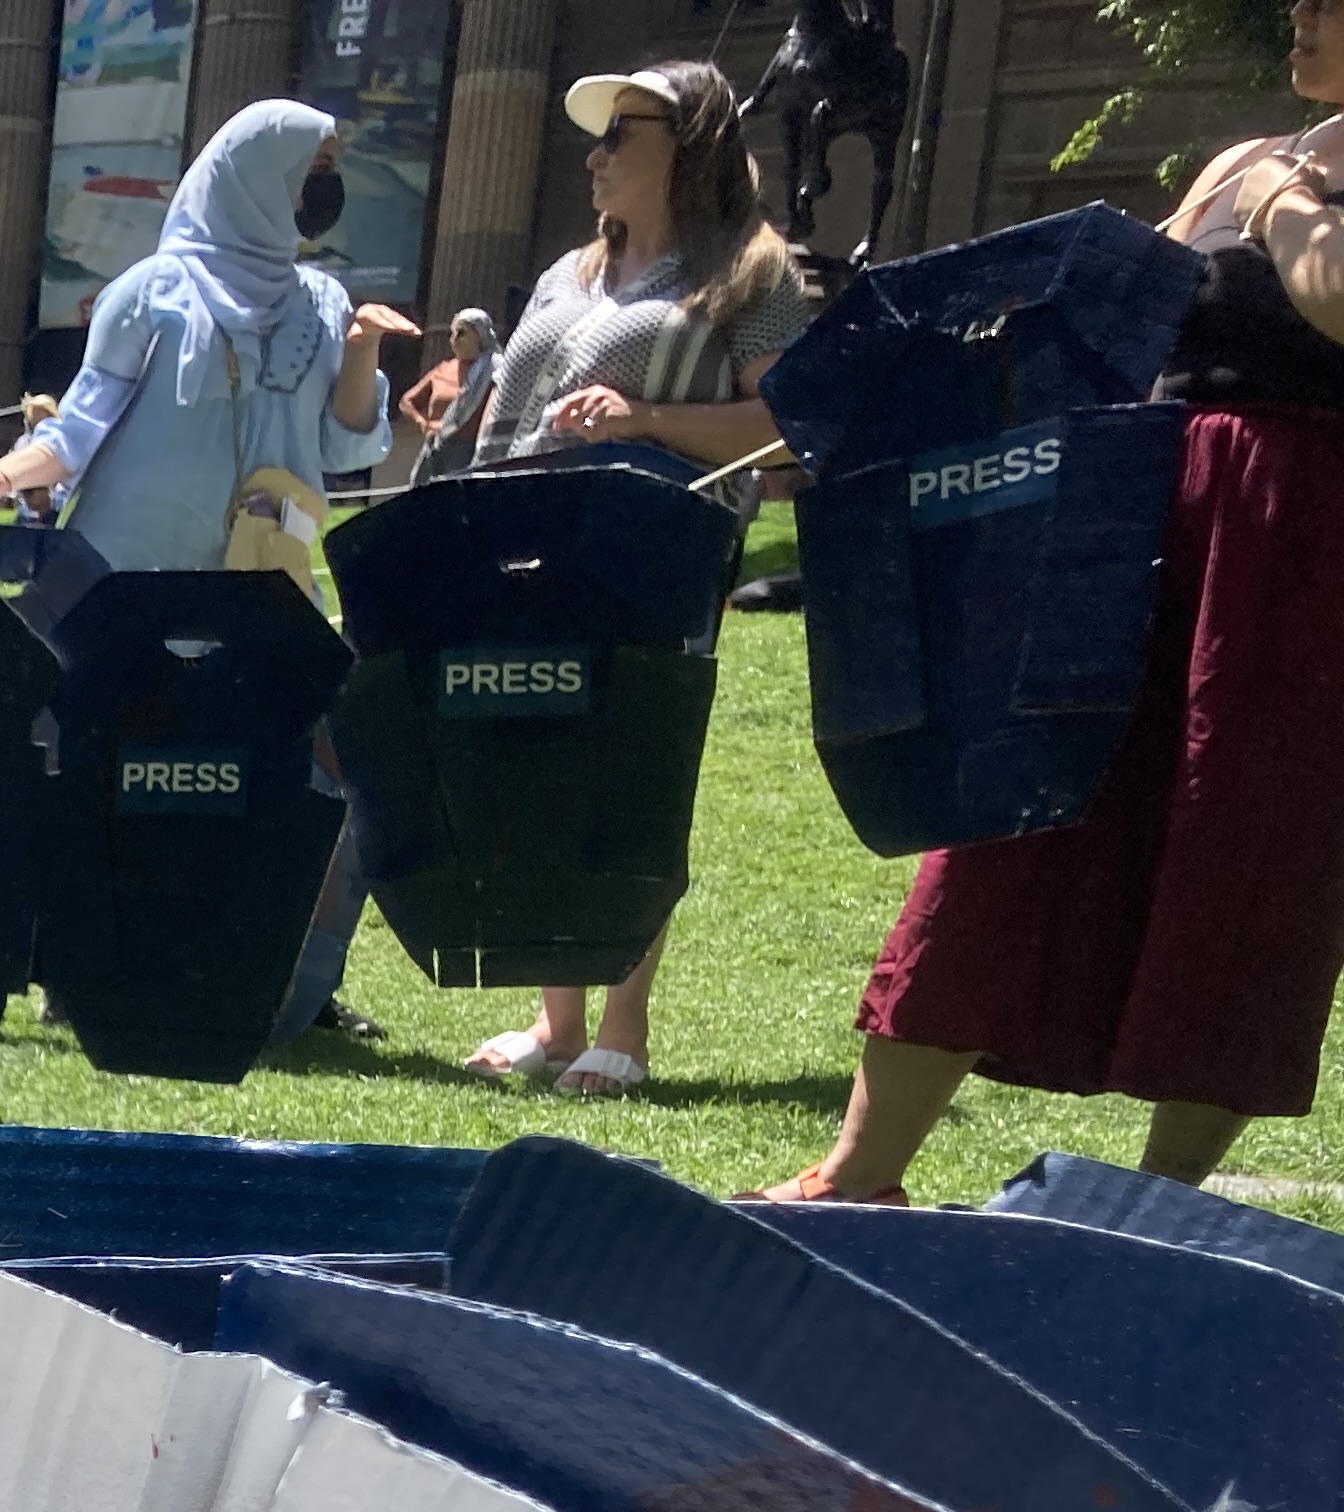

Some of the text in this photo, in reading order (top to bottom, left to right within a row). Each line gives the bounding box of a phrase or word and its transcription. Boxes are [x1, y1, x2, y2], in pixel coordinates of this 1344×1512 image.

[909, 437, 1061, 507] PRESS
[445, 661, 582, 695] PRESS
[122, 762, 242, 794] PRESS
